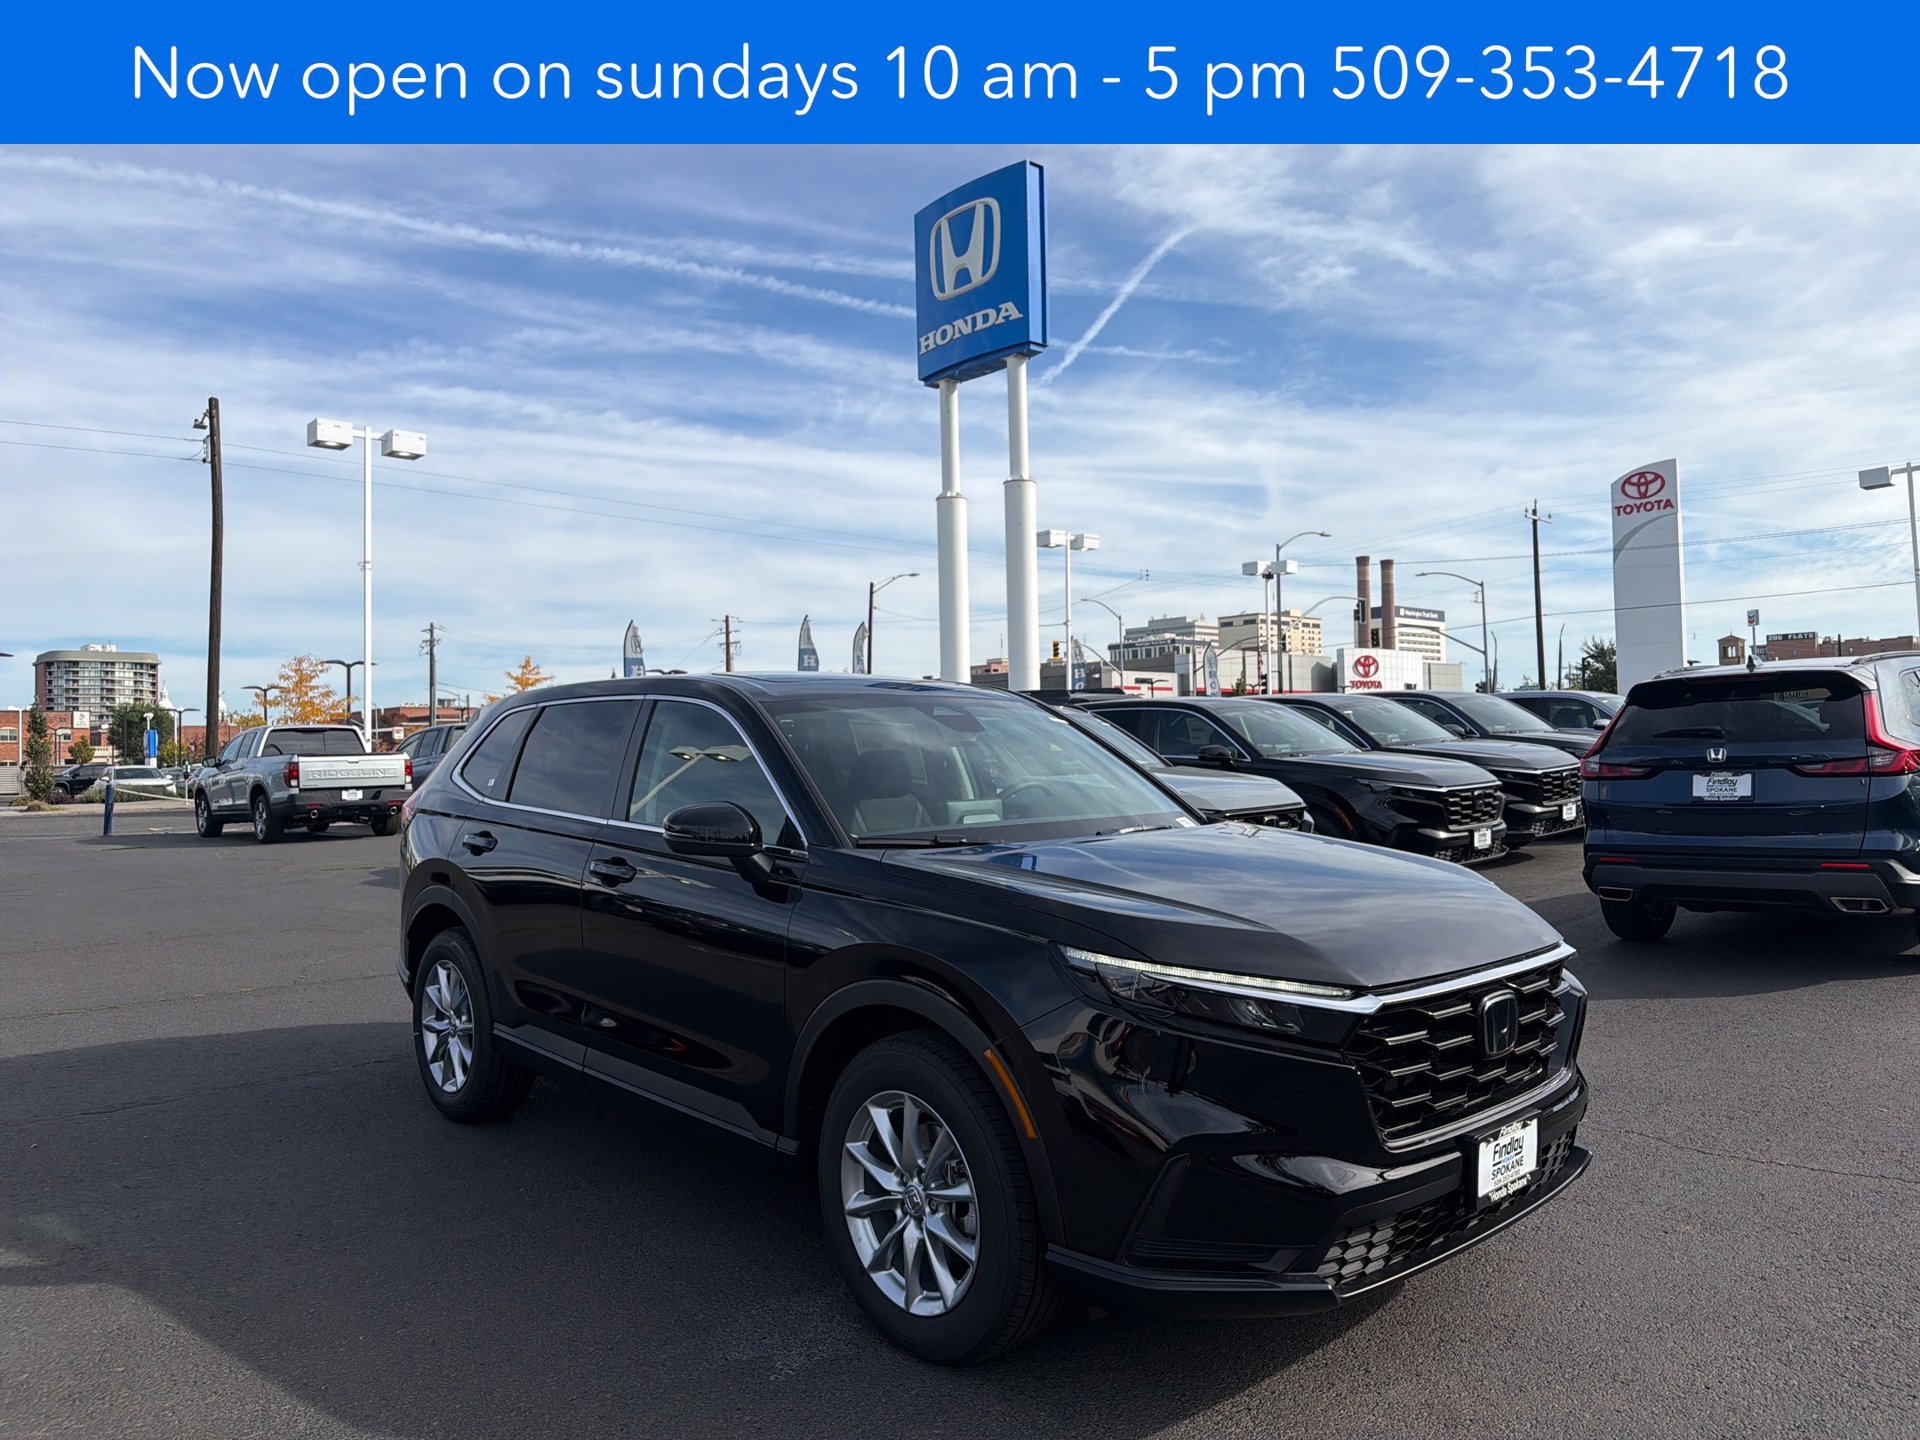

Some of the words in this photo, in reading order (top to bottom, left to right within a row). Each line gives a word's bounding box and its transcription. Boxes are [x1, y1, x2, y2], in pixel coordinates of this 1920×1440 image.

[919, 301, 1023, 355] HONDA
[1614, 498, 1674, 516] TOYOTA
[1788, 632, 1813, 640] FLATS
[1349, 680, 1382, 690] TOYOTA
[310, 768, 397, 778] RIDGELINE
[1707, 777, 1738, 787] Findlay
[1493, 1136, 1524, 1162] Findlay
[1491, 1156, 1524, 1180] SPOKANE
[1490, 1186, 1508, 1202] Honda
[1507, 1179, 1527, 1195] Spokane
